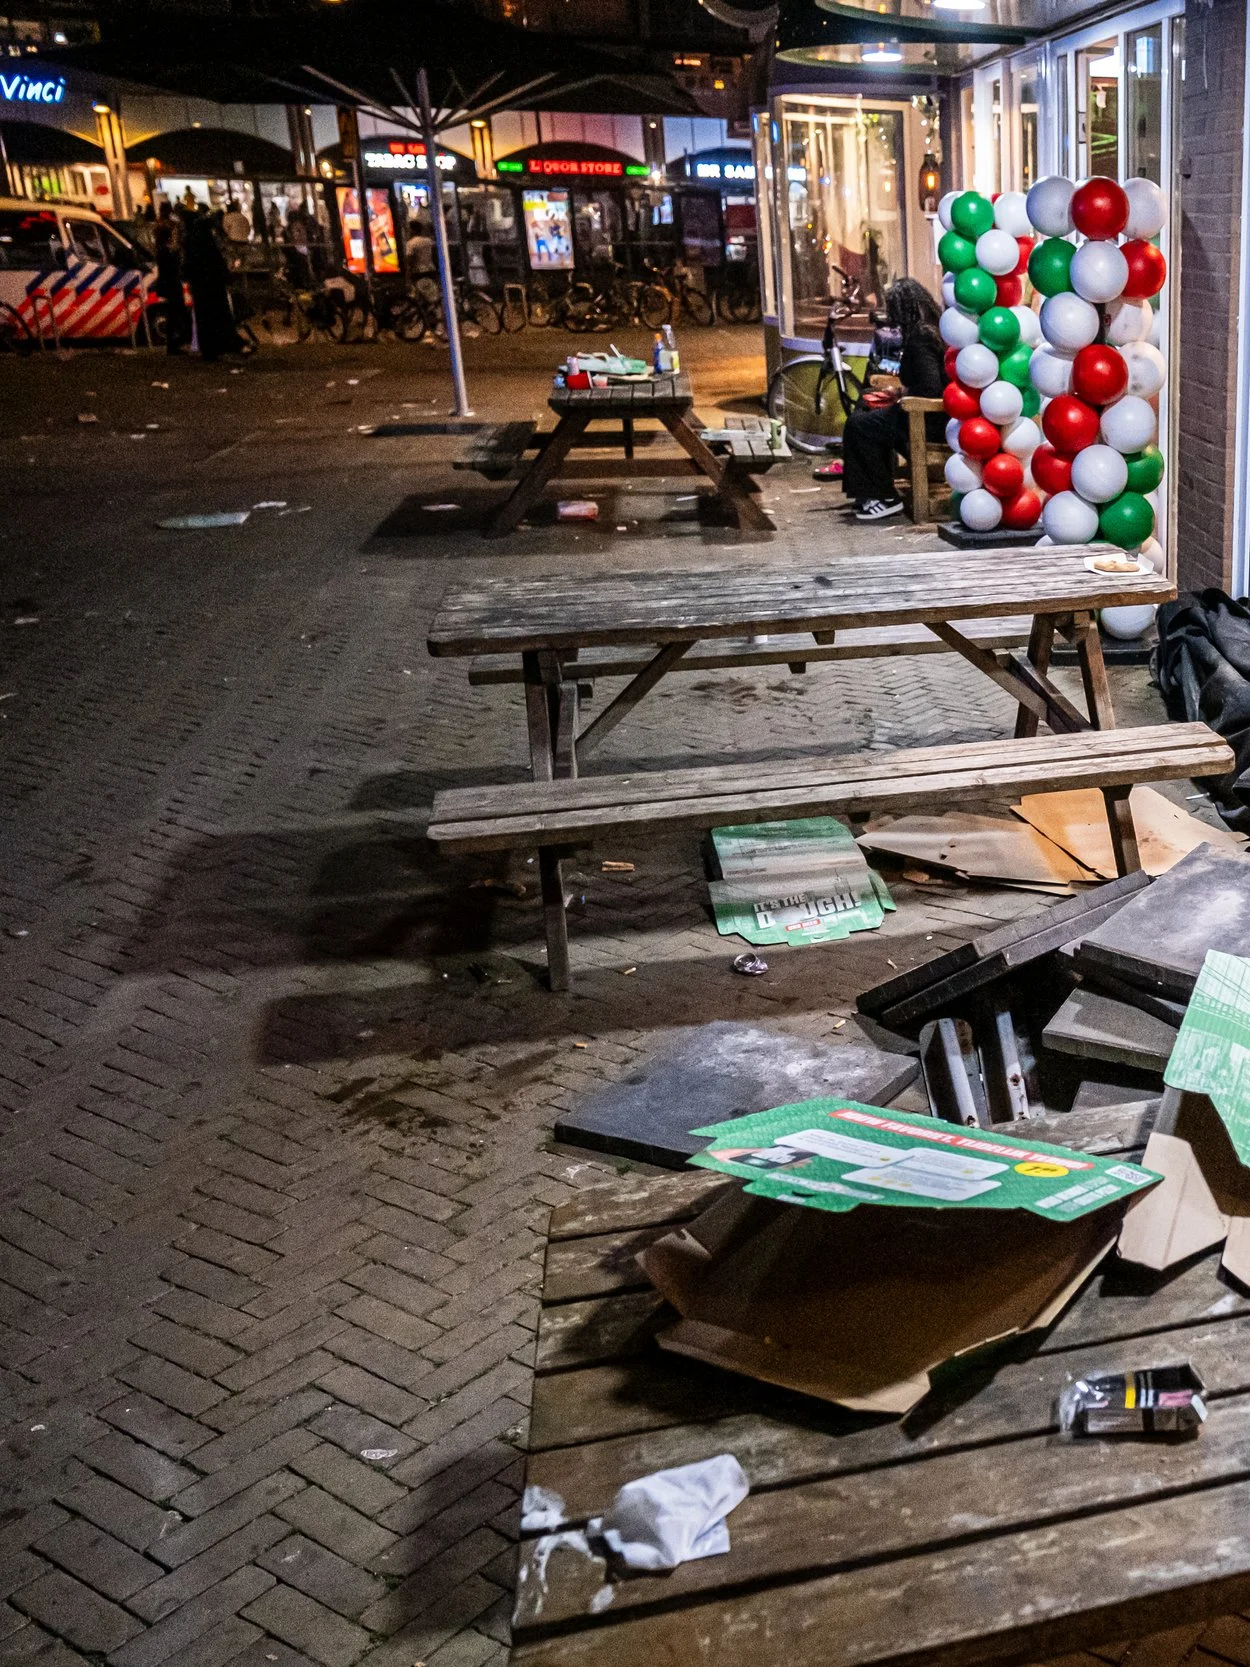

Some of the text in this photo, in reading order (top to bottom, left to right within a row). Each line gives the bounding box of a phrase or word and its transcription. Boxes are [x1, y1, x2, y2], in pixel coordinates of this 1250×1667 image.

[0, 75, 66, 103] Vinci
[530, 160, 578, 173] LQUOR
[580, 162, 621, 175] STORE
[781, 893, 808, 907] THE
